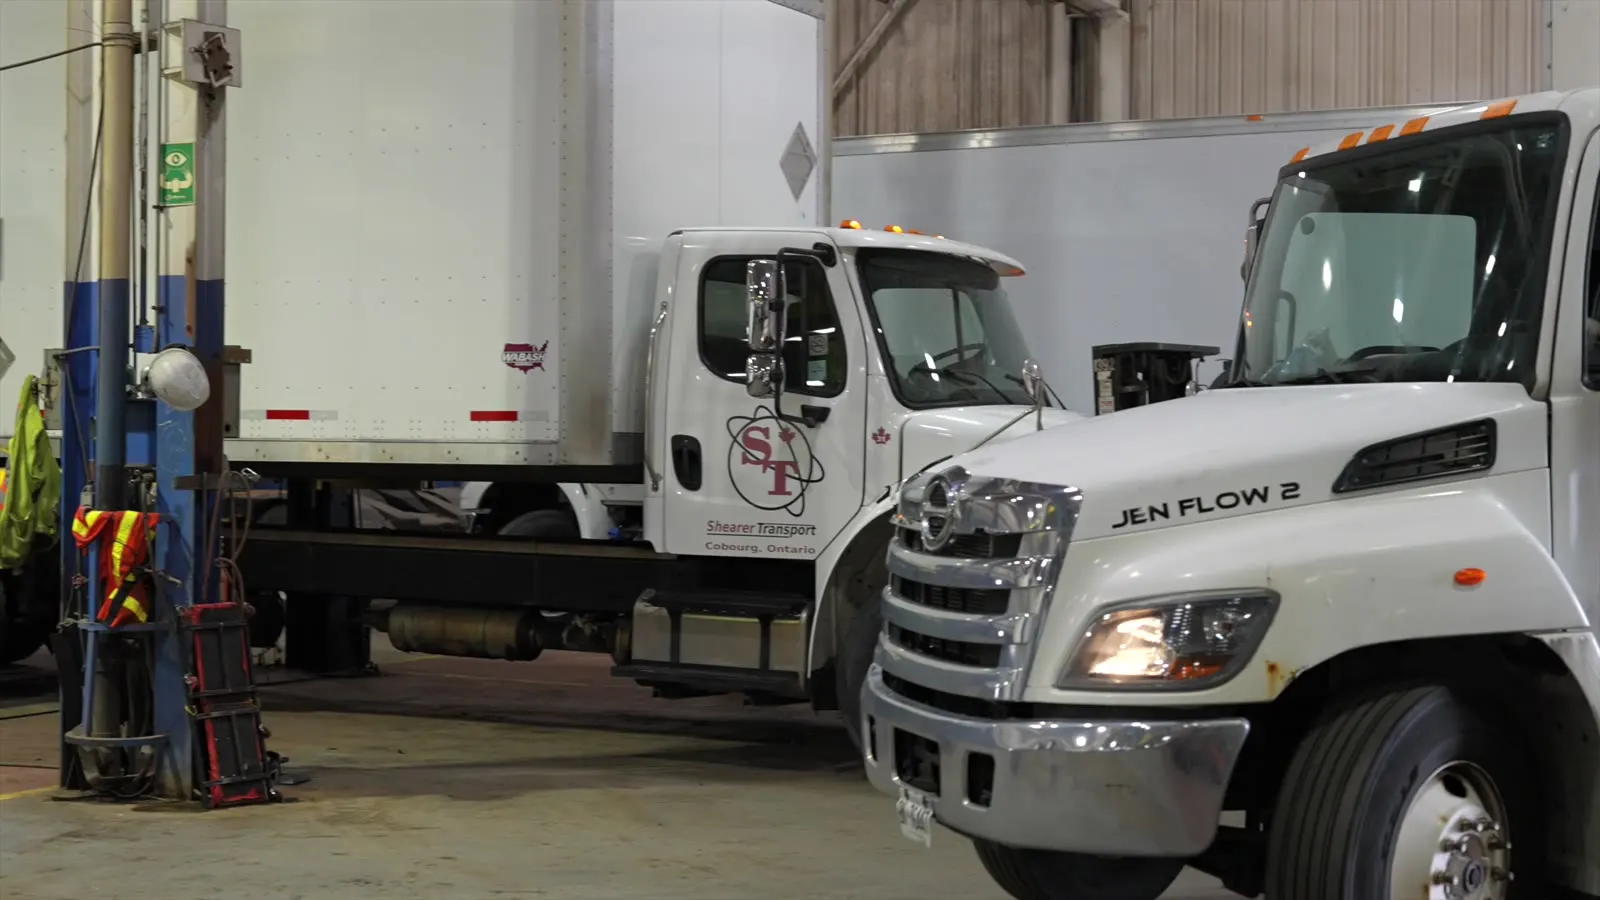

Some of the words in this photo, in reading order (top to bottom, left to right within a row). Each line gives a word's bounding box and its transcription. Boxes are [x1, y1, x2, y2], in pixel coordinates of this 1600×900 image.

[1111, 503, 1170, 529] JEN
[1178, 486, 1269, 516] FLOW
[1279, 482, 1301, 500] 2
[706, 520, 755, 533] Shearer
[757, 522, 816, 537] Transport
[767, 544, 816, 554] Ontario
